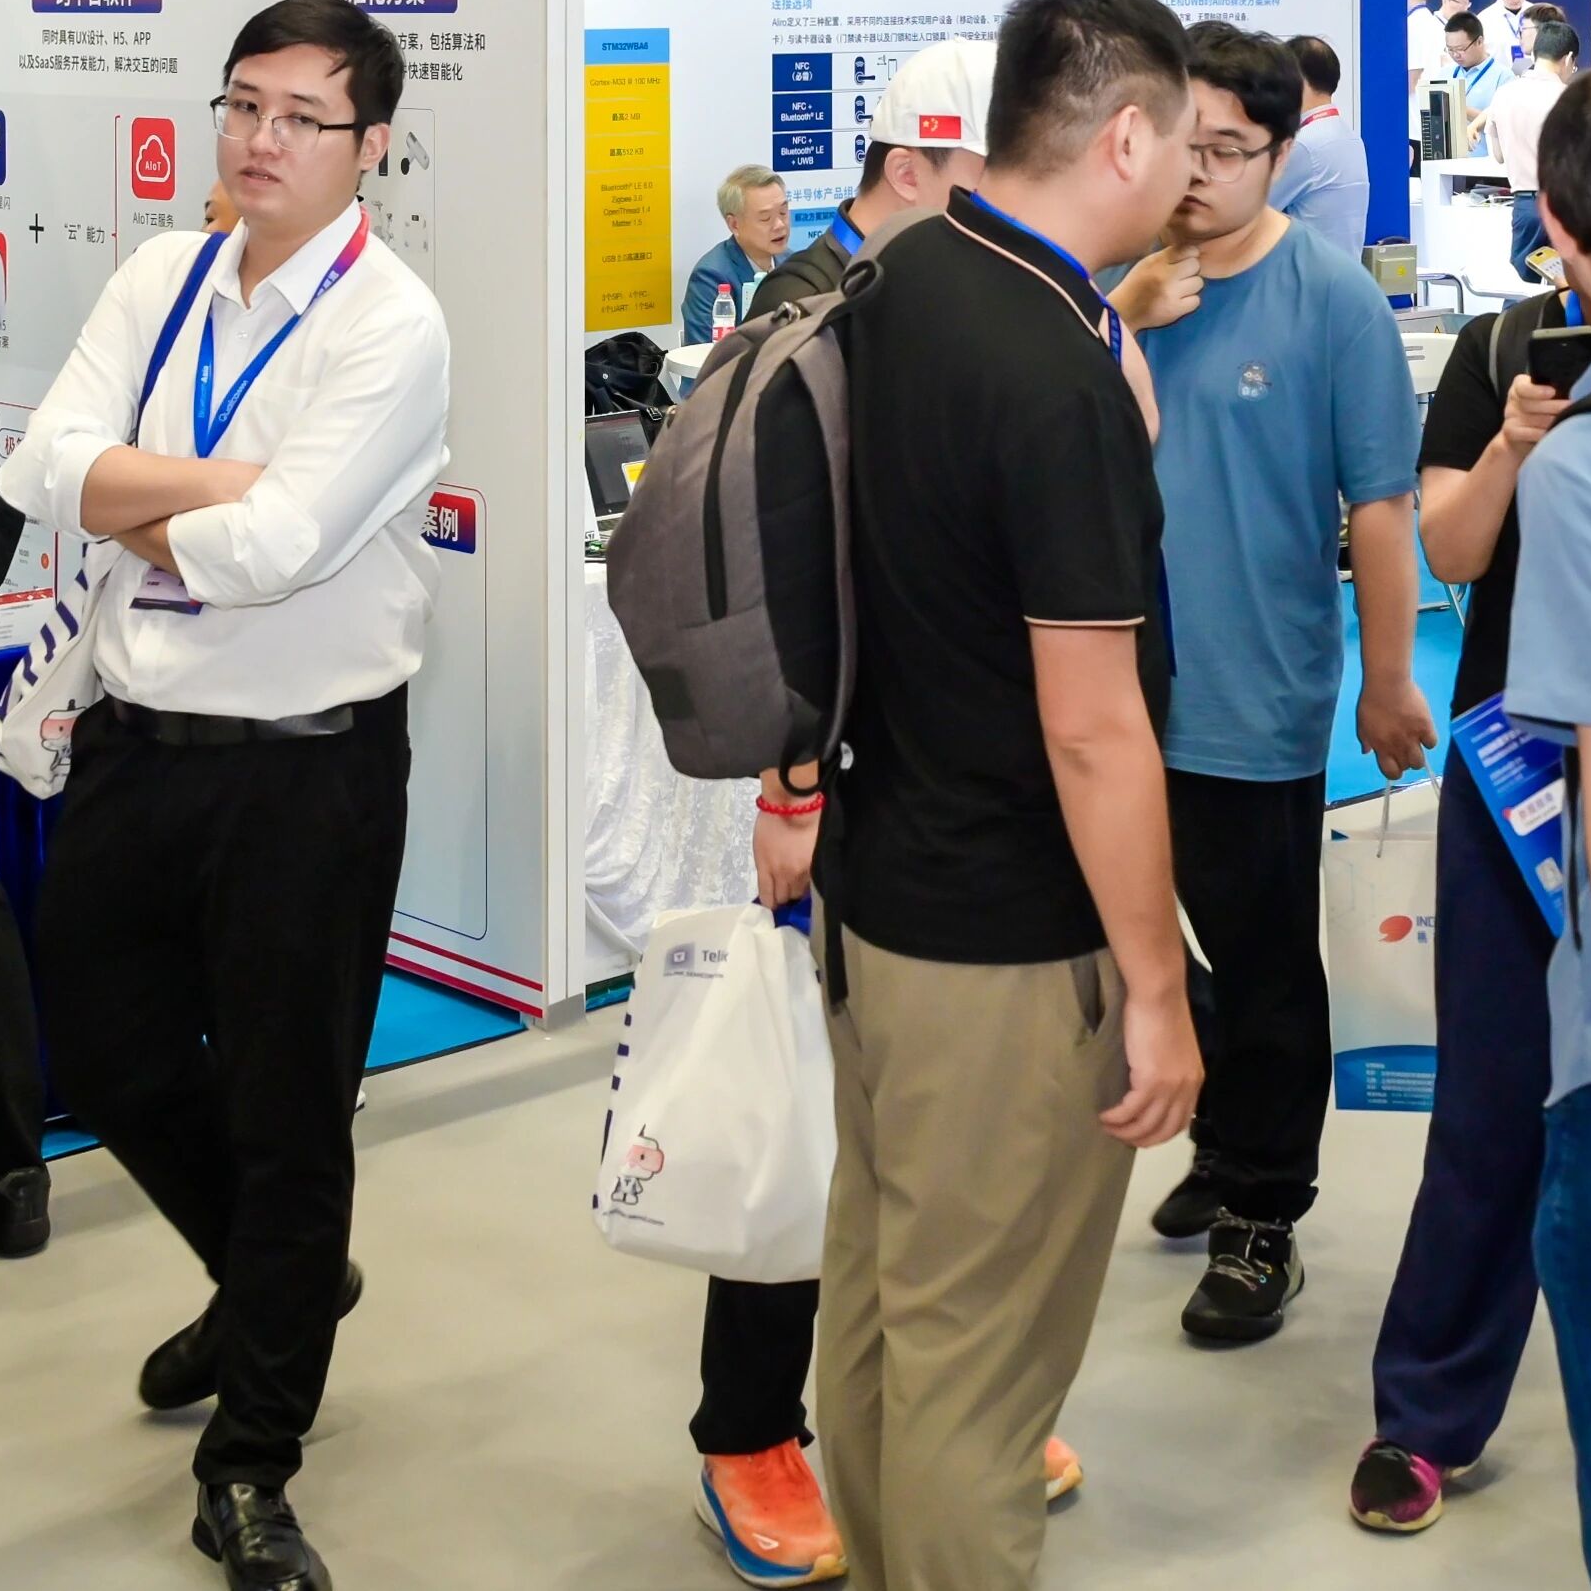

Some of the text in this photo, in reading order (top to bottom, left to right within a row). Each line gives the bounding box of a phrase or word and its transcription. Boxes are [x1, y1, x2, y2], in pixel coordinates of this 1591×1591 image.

[794, 62, 810, 70] NFC
[792, 102, 807, 111] NFC
[815, 112, 824, 121] LE
[792, 136, 807, 145] NFC
[815, 146, 824, 155] LE
[797, 156, 814, 166] UWB
[144, 161, 162, 172] AIoT
[132, 212, 174, 229] AIoT云服务
[218, 380, 249, 422] Qualcomm
